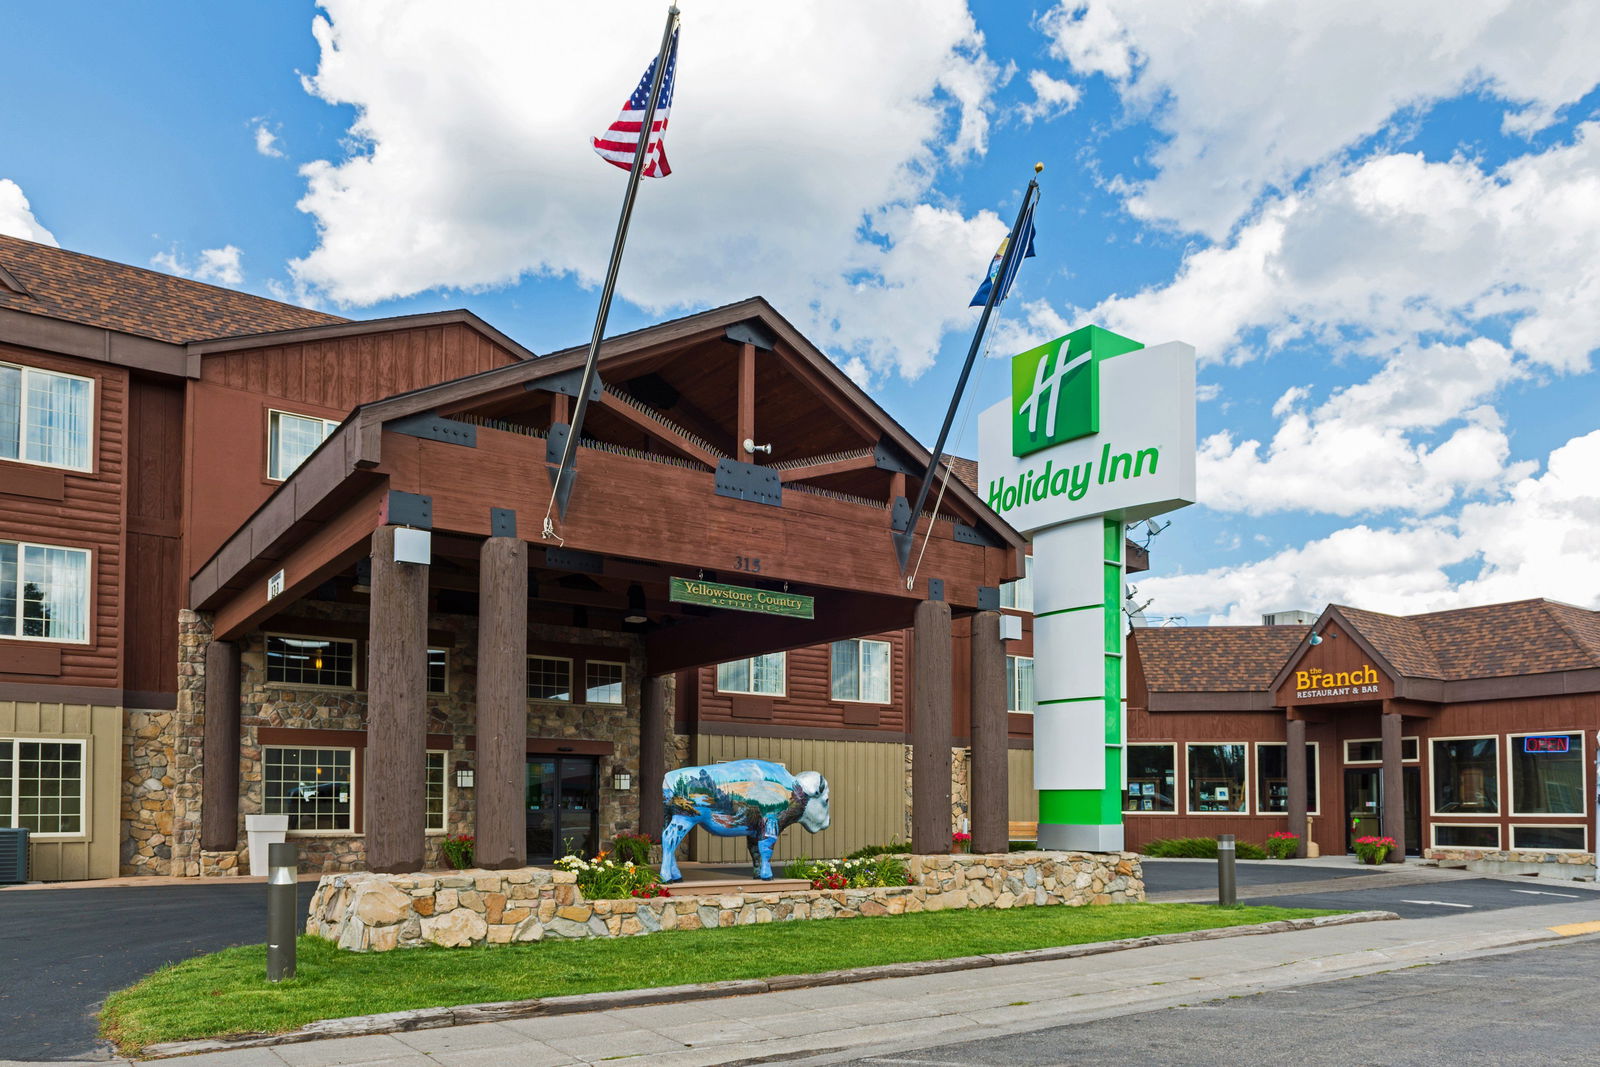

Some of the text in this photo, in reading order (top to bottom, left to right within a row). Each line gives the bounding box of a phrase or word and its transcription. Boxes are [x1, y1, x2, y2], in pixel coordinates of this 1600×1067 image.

[987, 443, 1160, 515] Holiday Inn
[734, 556, 761, 573] 315
[684, 581, 803, 610] Yellowstone Country
[711, 598, 781, 612] ACTIVITIES
[1295, 665, 1380, 690] Branch
[1309, 667, 1323, 675] the
[1296, 685, 1379, 699] RESTAURANT & BAR
[1527, 737, 1567, 751] OPEN
